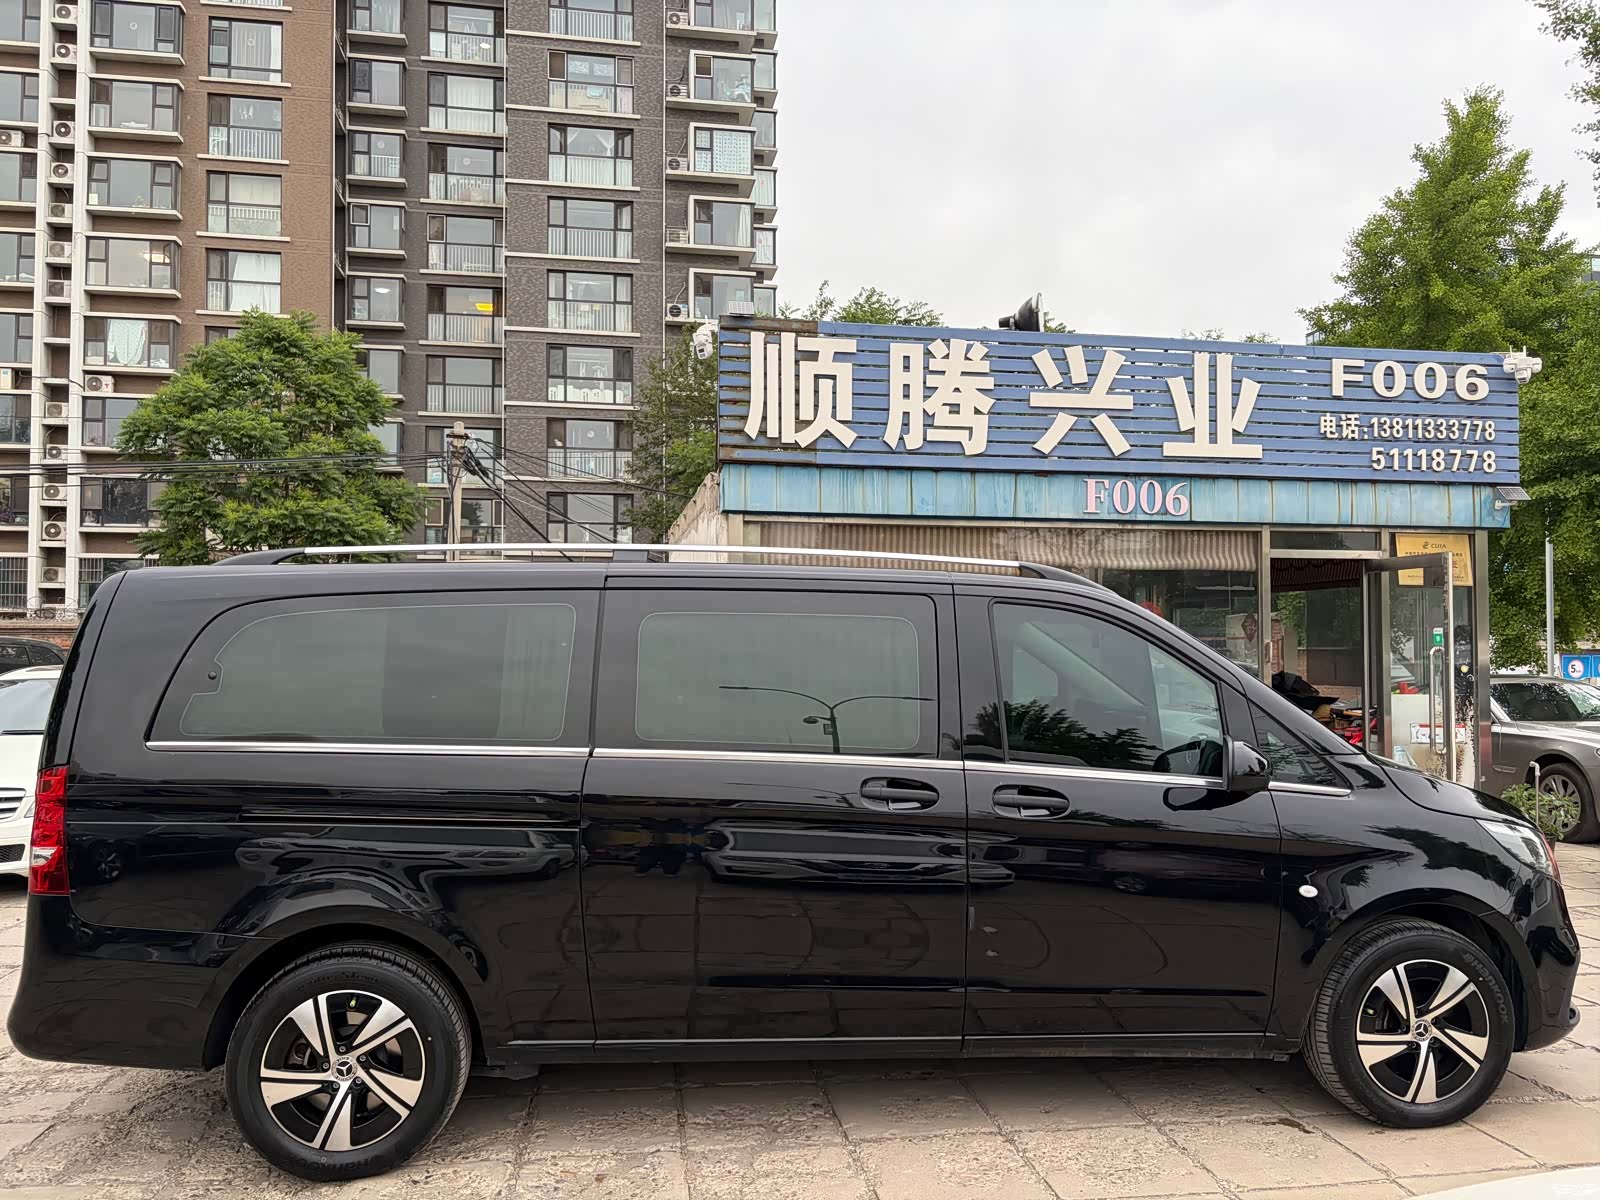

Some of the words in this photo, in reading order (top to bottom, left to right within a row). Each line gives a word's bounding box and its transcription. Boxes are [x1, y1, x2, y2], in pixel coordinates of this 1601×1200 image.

[744, 332, 1263, 458] 顺腾兴业
[1332, 359, 1490, 401] F006
[1372, 447, 1496, 473] 51118778
[1083, 478, 1189, 516] F006
